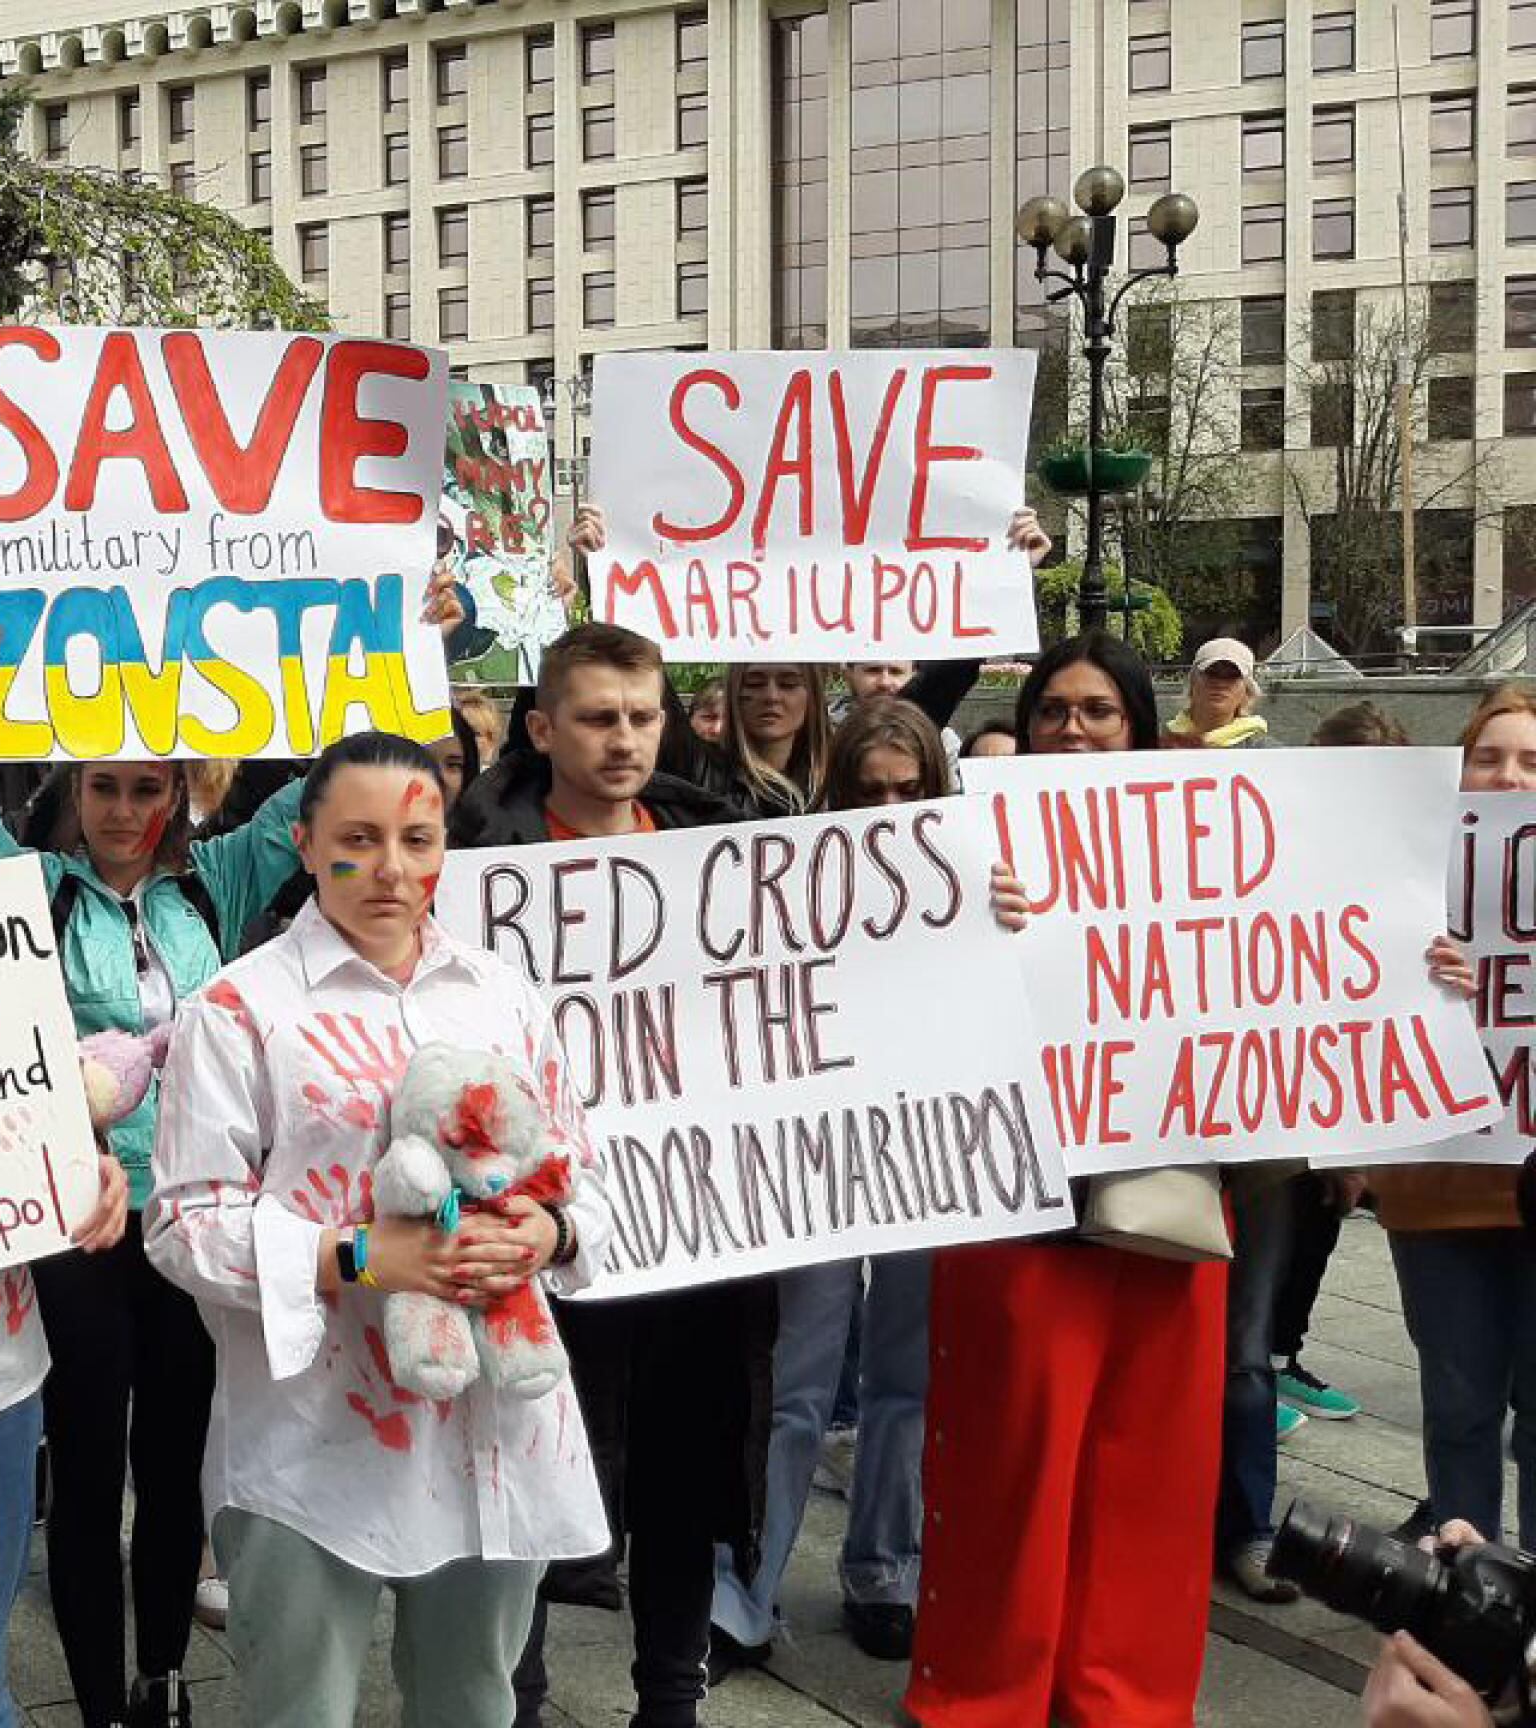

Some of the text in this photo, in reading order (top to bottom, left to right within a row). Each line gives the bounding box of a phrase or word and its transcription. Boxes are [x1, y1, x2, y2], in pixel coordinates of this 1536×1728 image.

[455, 400, 543, 432] IUPOL
[653, 366, 993, 560] SAVE
[0, 514, 181, 575] military
[207, 514, 317, 573] from
[466, 497, 550, 556] RE?
[606, 554, 996, 641] MARIUPOL
[480, 808, 963, 984] RED CROSS
[993, 774, 1275, 915] UNITED
[1086, 904, 1380, 1025] NATIONS
[553, 958, 854, 1108] OIN THE
[1159, 1015, 1488, 1137] AZOVSTAL
